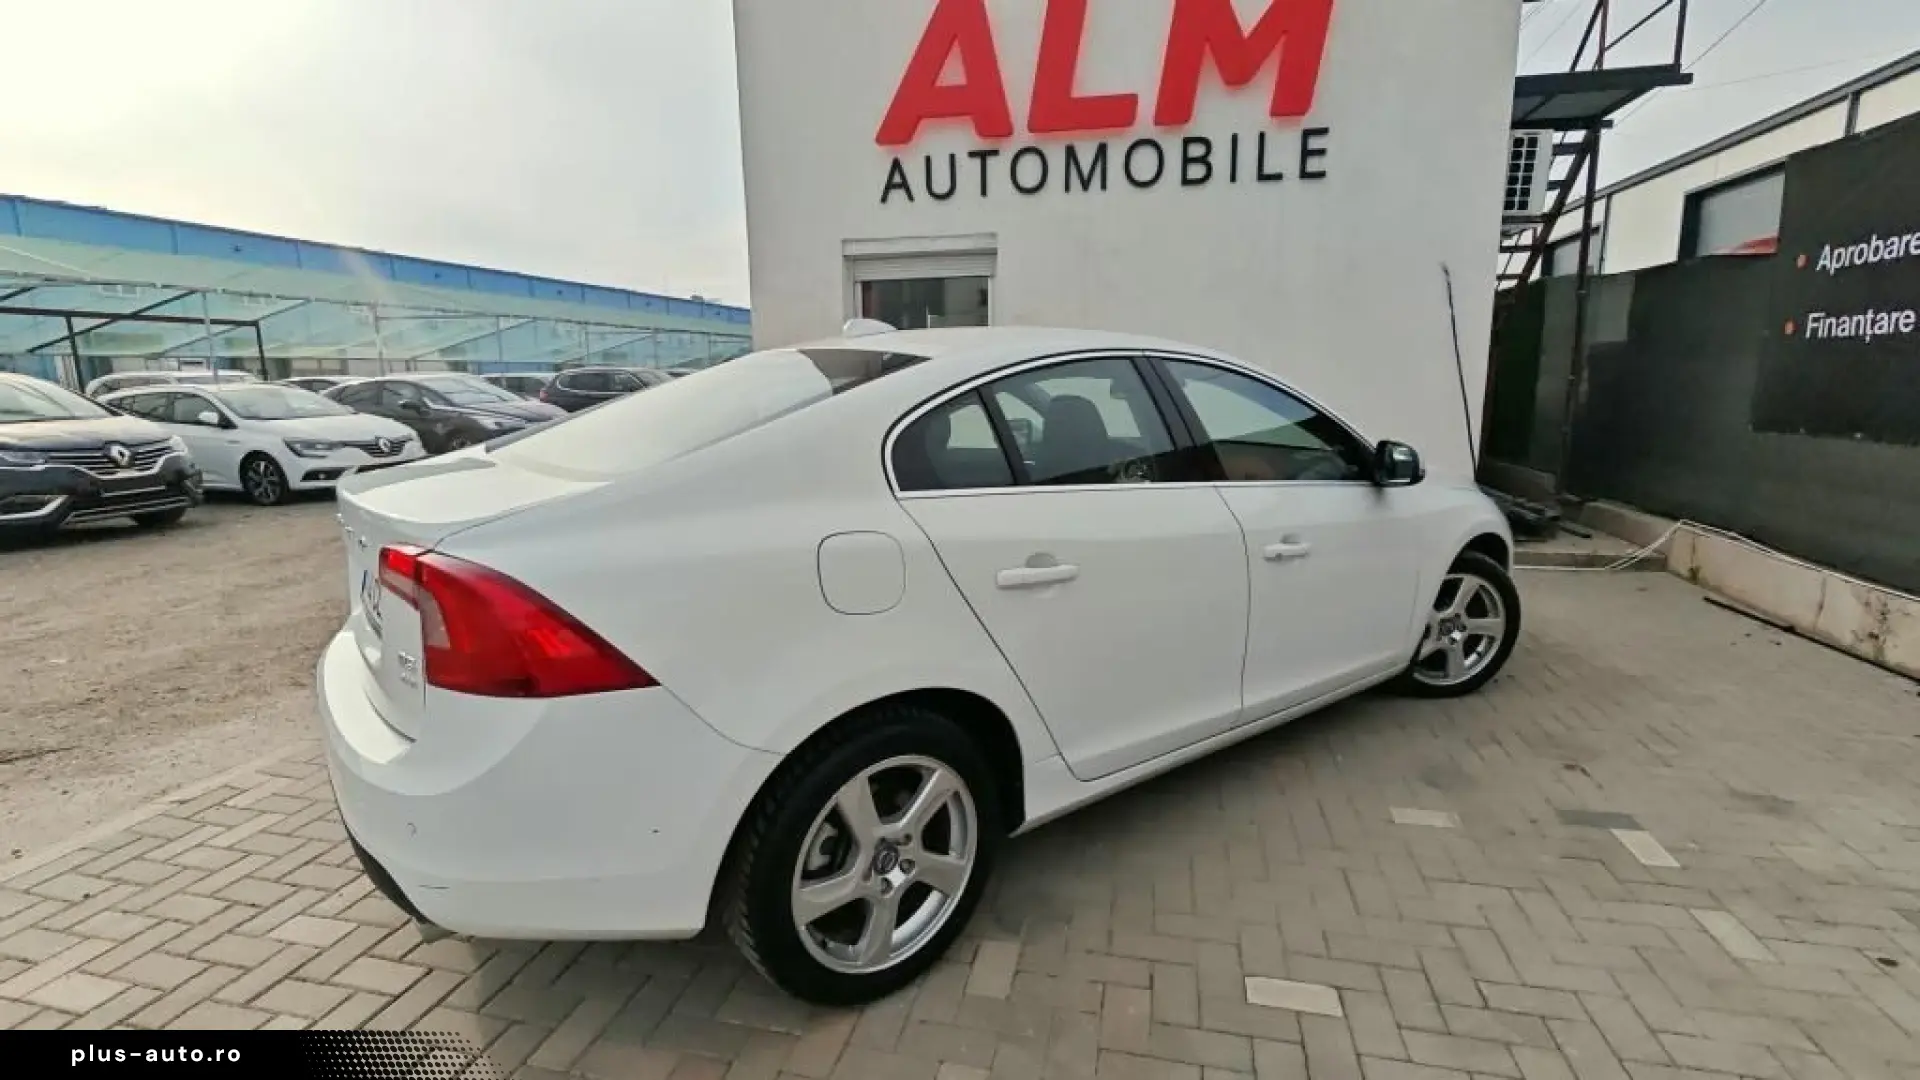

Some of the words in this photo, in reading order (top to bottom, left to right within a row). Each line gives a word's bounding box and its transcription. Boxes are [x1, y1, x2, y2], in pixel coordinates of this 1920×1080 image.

[876, 0, 1334, 147] ALM
[880, 127, 1330, 204] AUTOMOBILE
[1815, 231, 1920, 276] Aprobare
[1805, 308, 1916, 343] Finanțare
